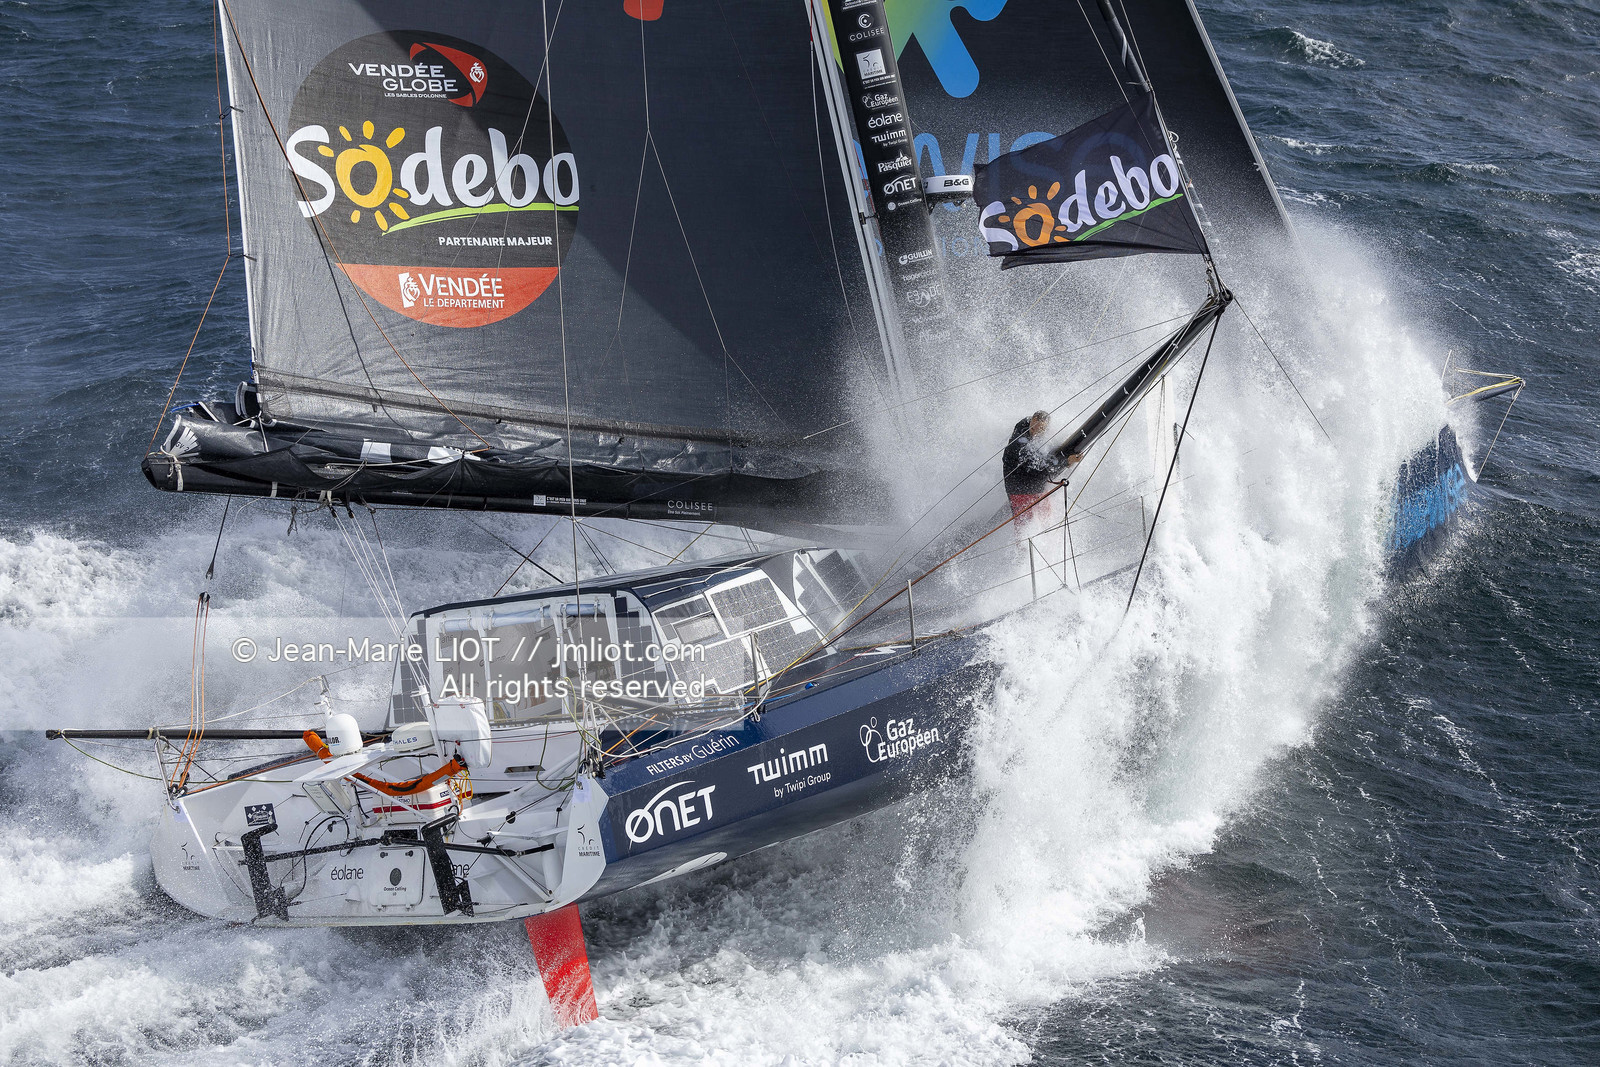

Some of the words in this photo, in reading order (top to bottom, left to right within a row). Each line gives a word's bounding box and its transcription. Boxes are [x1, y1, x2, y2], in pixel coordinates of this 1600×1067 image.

[348, 62, 446, 78] VENDÉE
[382, 78, 458, 92] GLOBE
[868, 113, 902, 128] éolane
[286, 124, 579, 217] Sodebo
[878, 159, 912, 173] Pasquier
[944, 179, 969, 187] B&G
[978, 153, 1179, 251] Sodebo
[438, 236, 505, 246] PARTENAIRE
[507, 236, 552, 246] MAJEUR
[418, 273, 505, 297] VENDÉE
[423, 297, 435, 307] LE
[886, 717, 915, 740] Gaz
[878, 728, 940, 762] Européen
[646, 755, 684, 777] FILTERS
[682, 753, 694, 764] BY
[692, 734, 740, 760] Guérin
[773, 786, 784, 799] by
[784, 778, 807, 794] Twipi
[807, 771, 832, 787] Group
[330, 864, 364, 881] éolane
